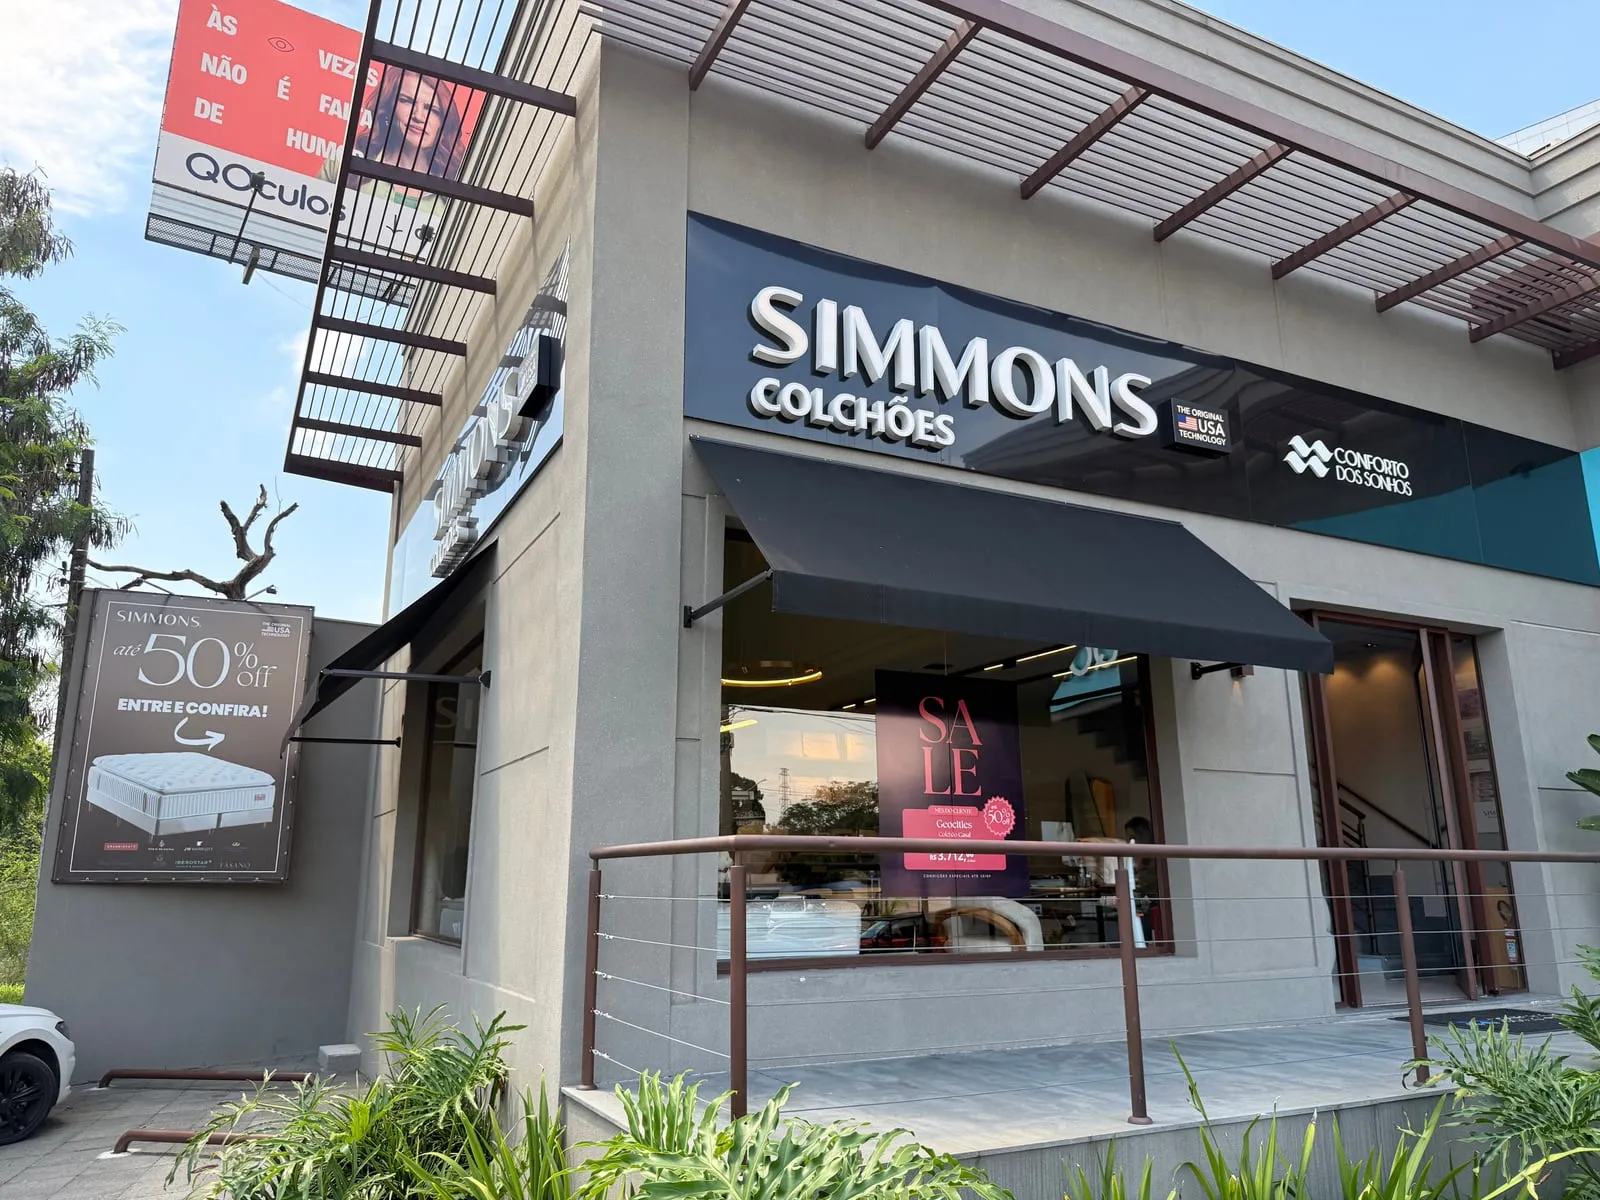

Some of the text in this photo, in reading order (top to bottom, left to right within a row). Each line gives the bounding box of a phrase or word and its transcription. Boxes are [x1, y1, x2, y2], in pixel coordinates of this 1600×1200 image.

[206, 4, 379, 87] ÀS VEZS
[200, 52, 373, 130] NÃO É FALA
[193, 96, 225, 125] DE
[750, 285, 1159, 438] SIMMONS
[750, 376, 957, 450] COLCHÕES
[1176, 404, 1225, 423] THE ORIGINAL
[1178, 429, 1228, 446] TECHNOLOGY
[1198, 418, 1227, 438] USA
[1333, 447, 1410, 479] CONFORTO
[1335, 464, 1413, 497] DOS SONHOS
[116, 609, 201, 628] SIMMONS
[274, 626, 291, 634] USA
[113, 643, 142, 657] até
[236, 665, 278, 688] off
[117, 698, 269, 718] ENTRE E CONFIRA!
[936, 819, 973, 829] Geocities
